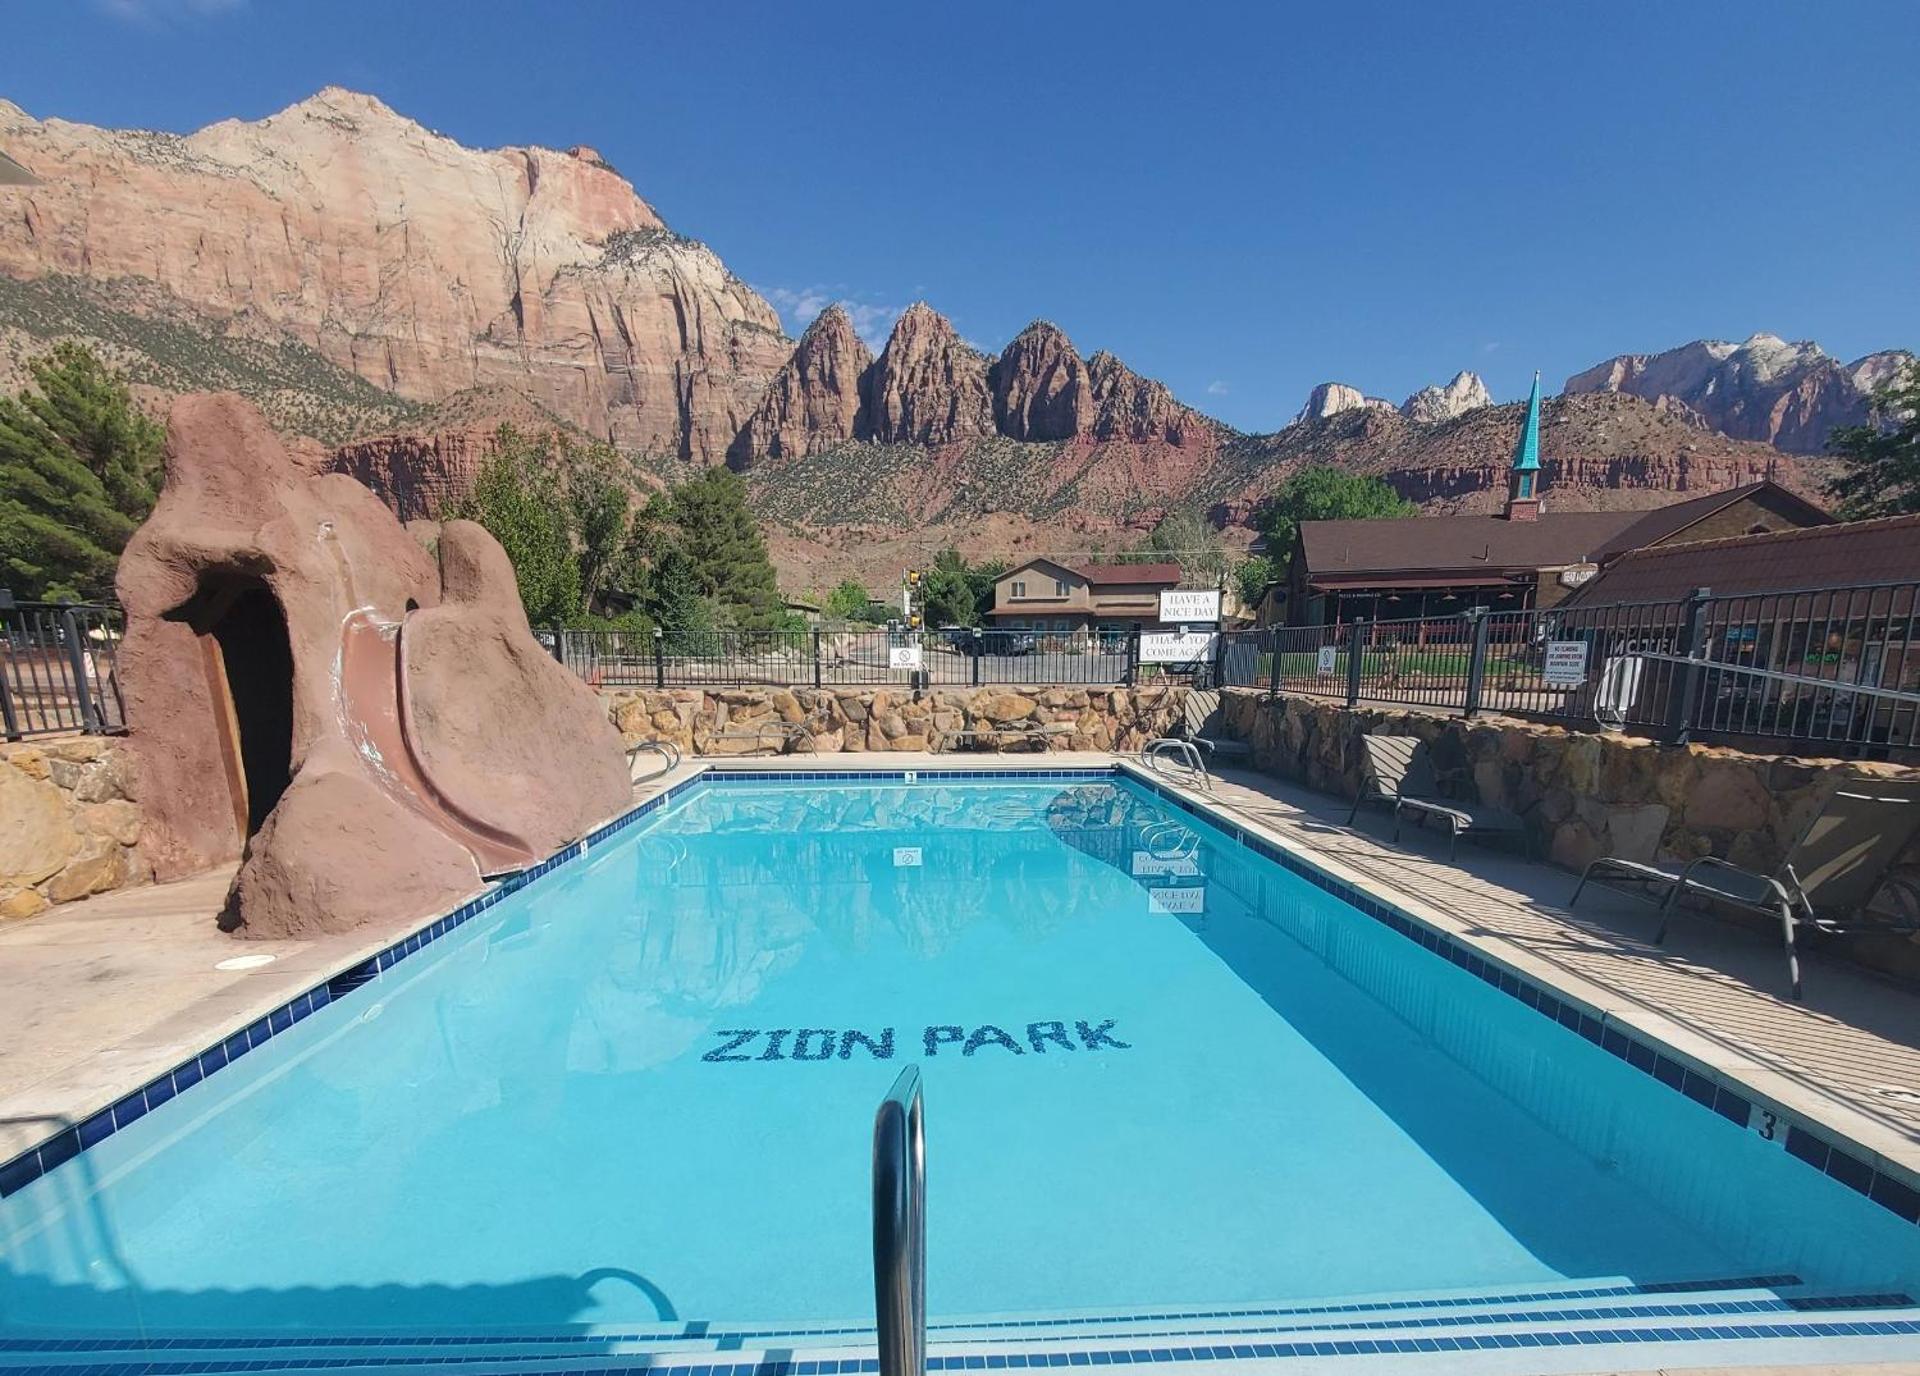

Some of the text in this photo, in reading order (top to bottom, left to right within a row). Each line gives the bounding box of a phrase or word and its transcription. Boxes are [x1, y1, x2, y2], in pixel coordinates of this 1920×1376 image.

[1170, 595, 1210, 604] HAVE A
[1164, 607, 1215, 617] NICE DAY
[1149, 635, 1185, 645] THANK
[1146, 648, 1176, 658] COME
[701, 1019, 1131, 1062] ZION PARK
[1758, 1110, 1777, 1141] 3
